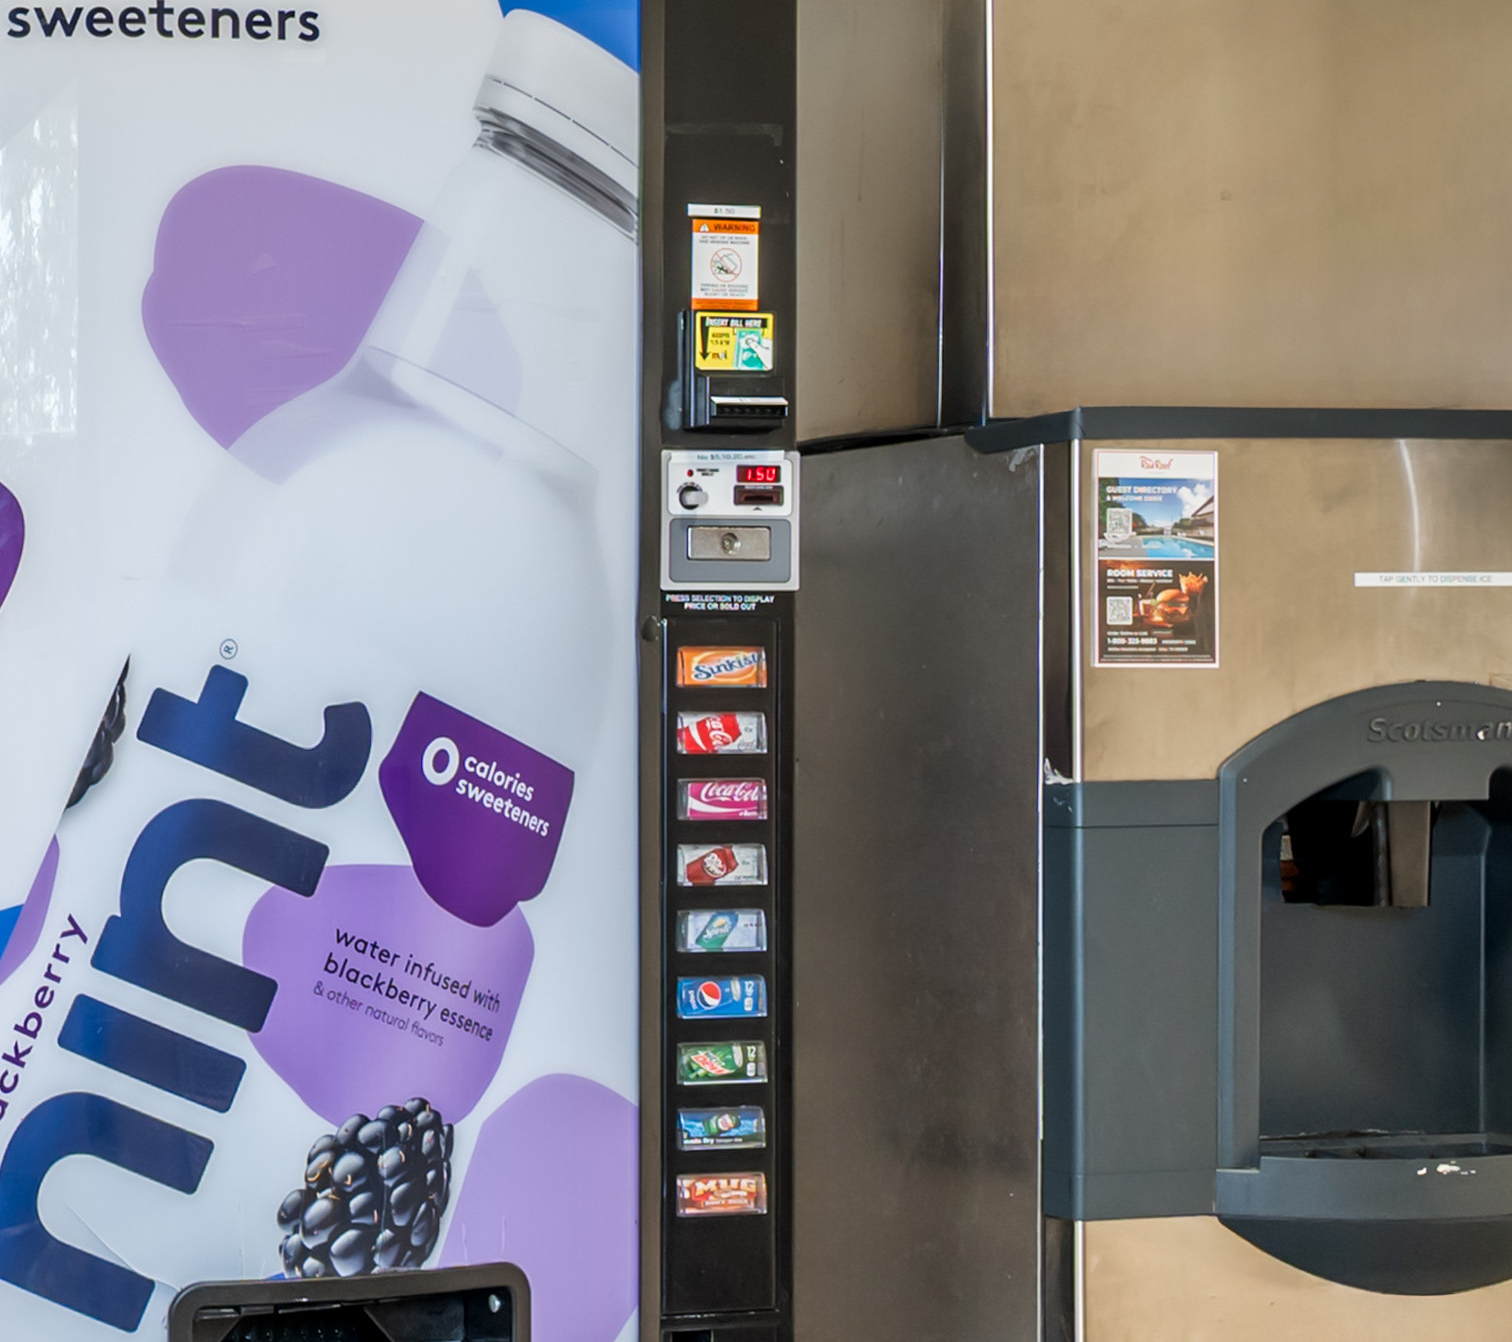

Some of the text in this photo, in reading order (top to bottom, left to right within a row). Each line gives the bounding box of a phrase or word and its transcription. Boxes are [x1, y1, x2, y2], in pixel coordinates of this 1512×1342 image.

[746, 467, 777, 481] 1.50
[1107, 569, 1173, 577] ROOM SERVICE
[1428, 575, 1438, 583] TO
[1479, 575, 1492, 583] ICE
[684, 602, 705, 610] PRICE
[744, 595, 775, 603] DISPLAY
[693, 651, 759, 680] Sunkist
[1367, 717, 1512, 743] Scotsman
[464, 755, 534, 802] calories
[456, 778, 550, 837] sweeteners
[335, 928, 500, 1013] water infused with
[324, 952, 493, 1042] blackberry essence
[313, 981, 445, 1047] & other natural flavors
